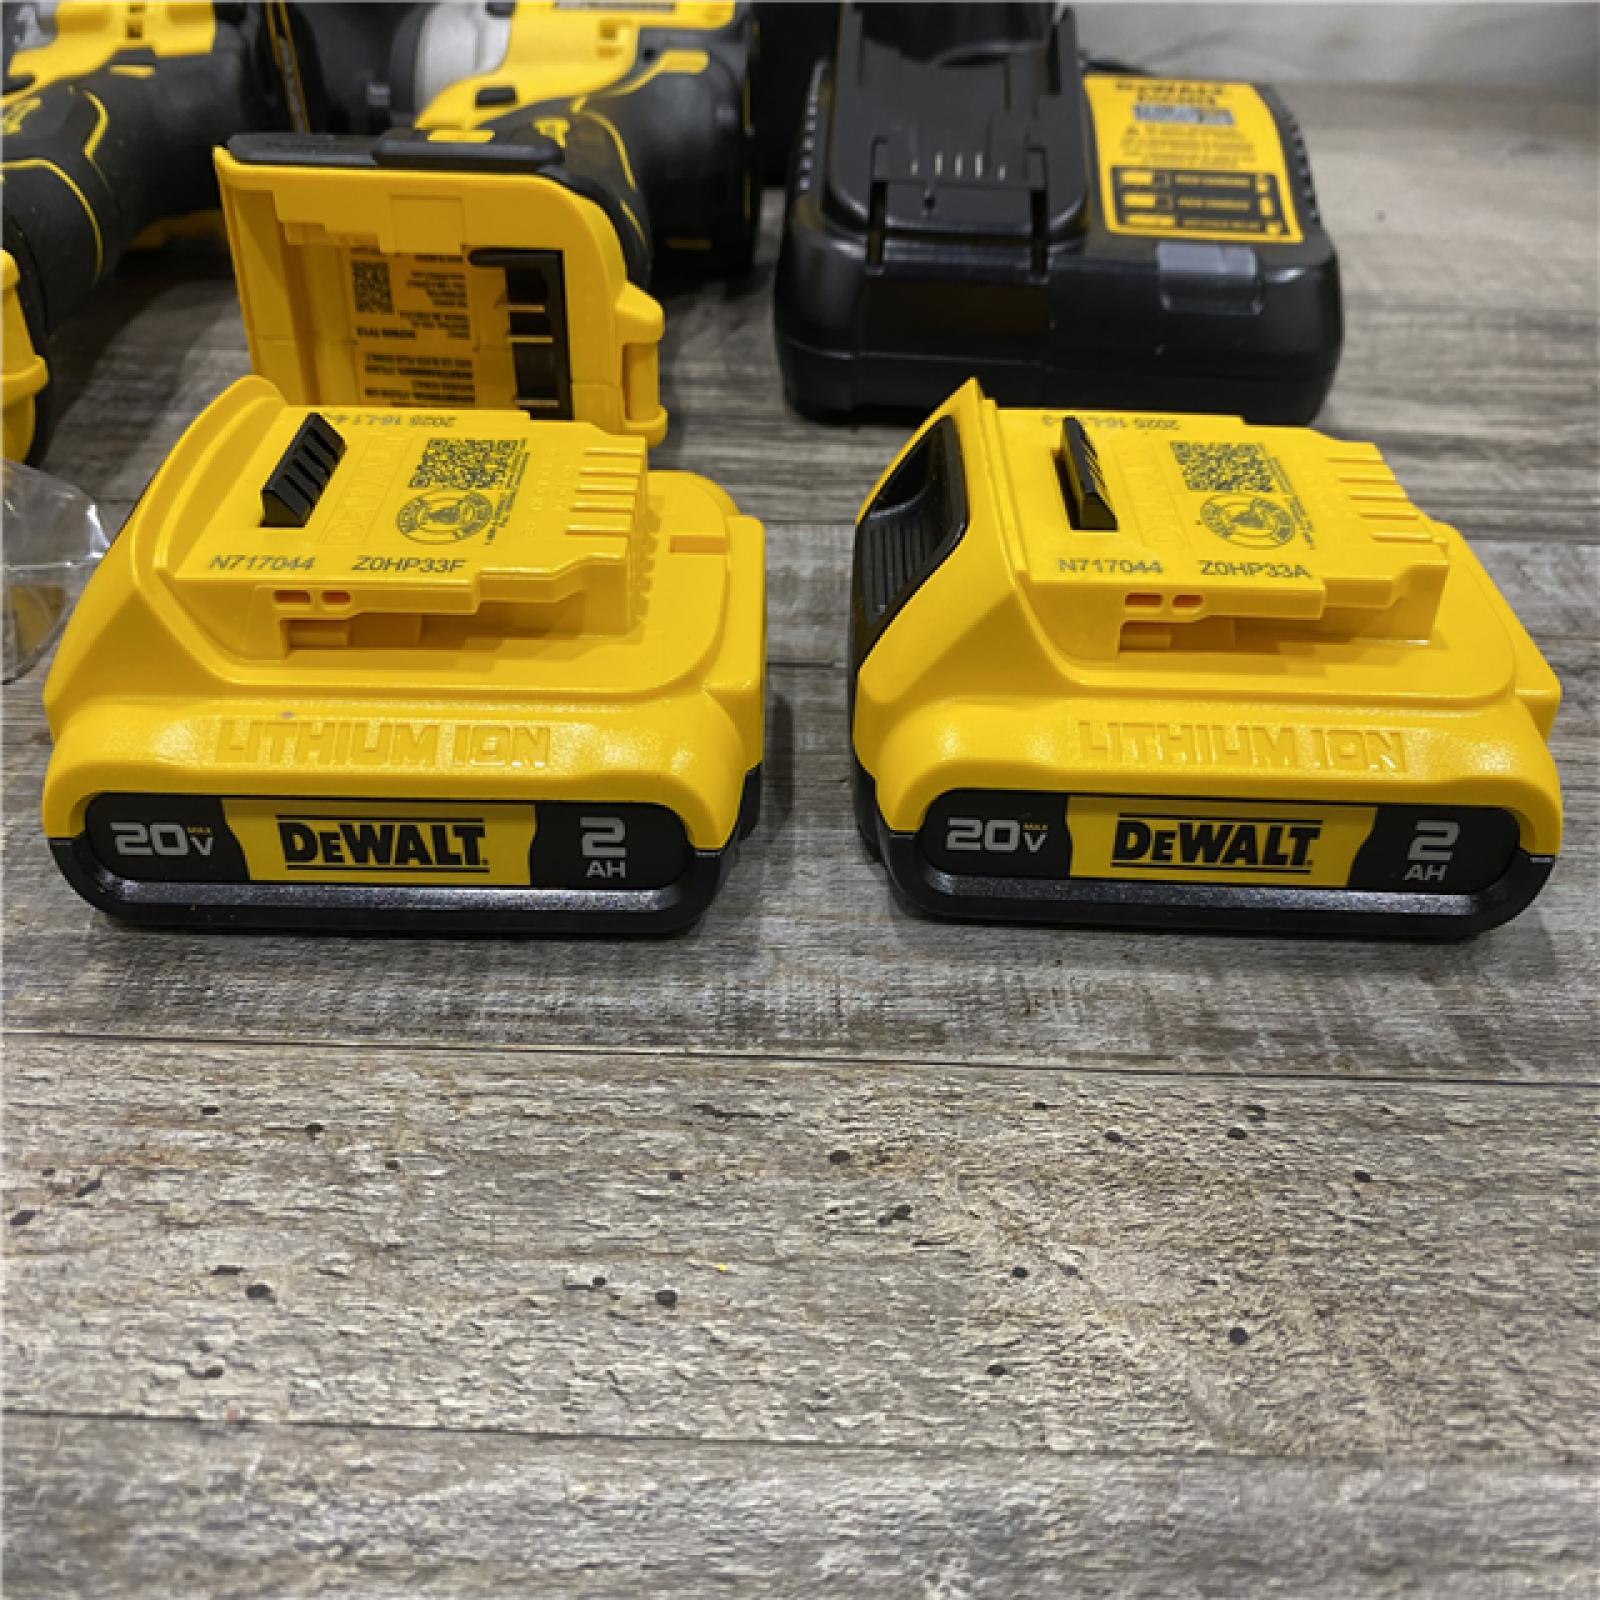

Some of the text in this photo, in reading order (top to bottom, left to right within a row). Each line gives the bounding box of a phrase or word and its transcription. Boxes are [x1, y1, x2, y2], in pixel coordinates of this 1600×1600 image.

[207, 554, 316, 572] N717044
[1057, 559, 1164, 575] N717044
[215, 719, 552, 769] LITHIUM ION
[1076, 720, 1409, 773] LITHIUM ION
[578, 816, 627, 860] 2
[1407, 819, 1461, 862] 2
[585, 861, 627, 879] AH
[1403, 862, 1449, 882] AH
